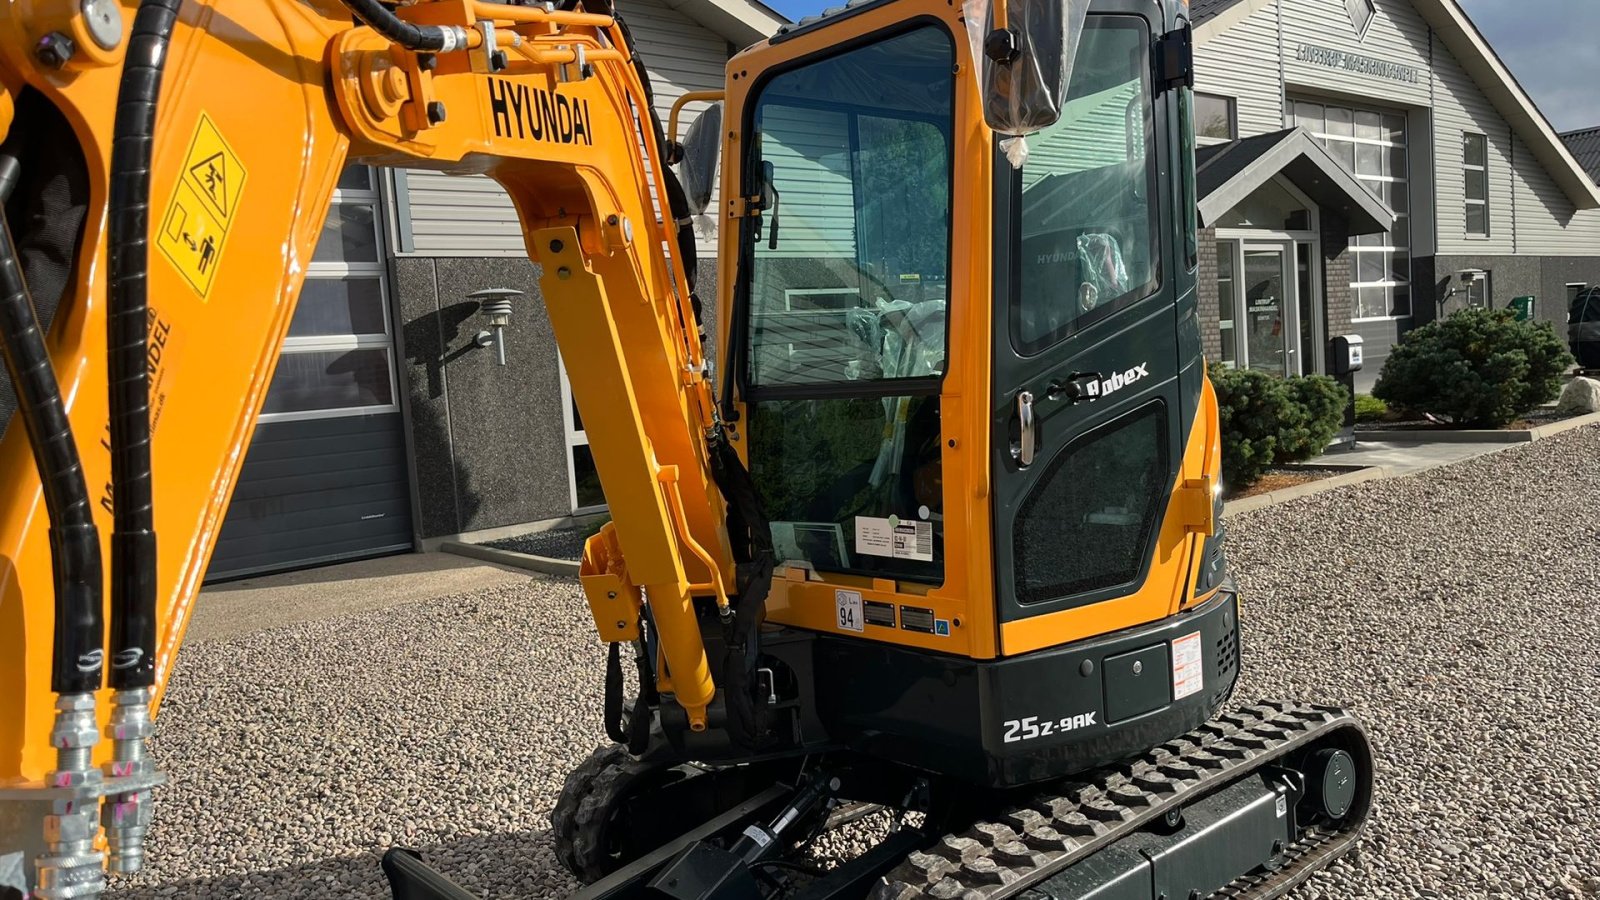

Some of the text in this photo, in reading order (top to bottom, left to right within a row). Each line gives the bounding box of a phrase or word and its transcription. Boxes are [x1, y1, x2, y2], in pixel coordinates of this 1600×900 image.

[487, 76, 593, 146] HYUNDAI
[1037, 251, 1079, 264] HYUND
[1086, 362, 1149, 402] Robex
[839, 607, 854, 628] 94
